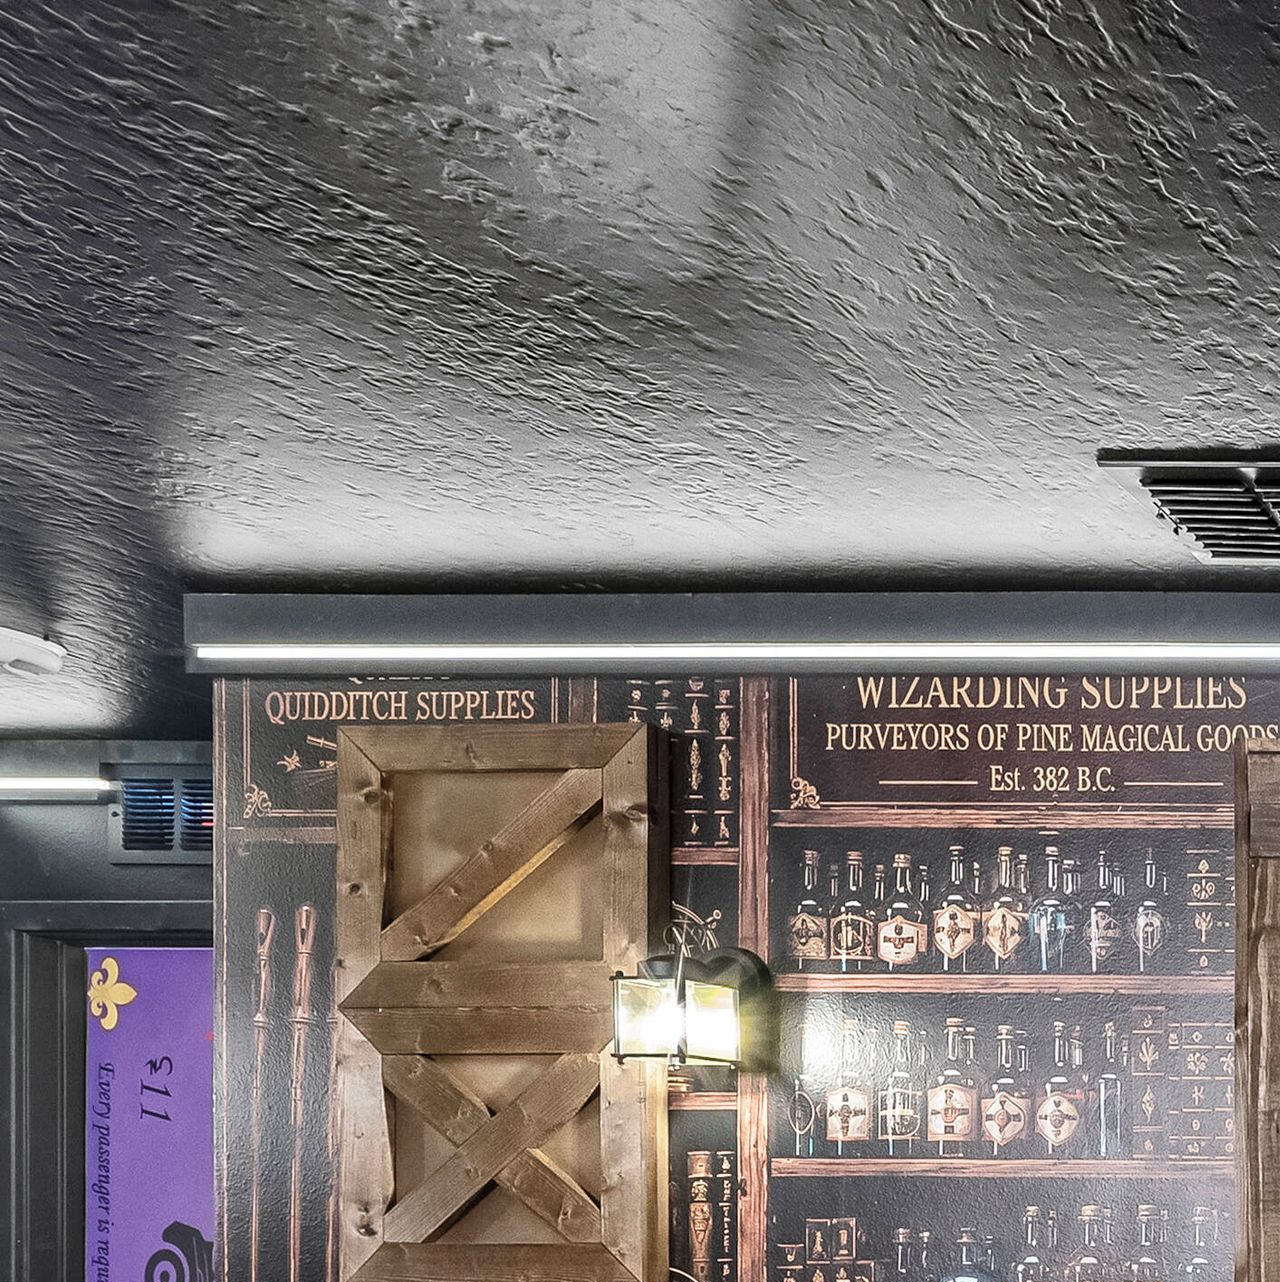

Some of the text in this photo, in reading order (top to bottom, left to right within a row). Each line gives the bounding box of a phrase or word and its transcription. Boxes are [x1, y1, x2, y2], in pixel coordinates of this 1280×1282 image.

[264, 690, 536, 725] QUIDDITCH SUPPLIES
[856, 676, 1247, 710] WIZARDING SUPPLIES
[825, 722, 970, 752] PURVEYORS
[977, 723, 1009, 751] OF
[1080, 724, 1191, 752] MAGICAL
[989, 765, 1116, 792] Est. 382 B.C.
[92, 1062, 115, 1119] Every
[91, 1122, 109, 1214] passenger
[97, 1218, 115, 1234] is
